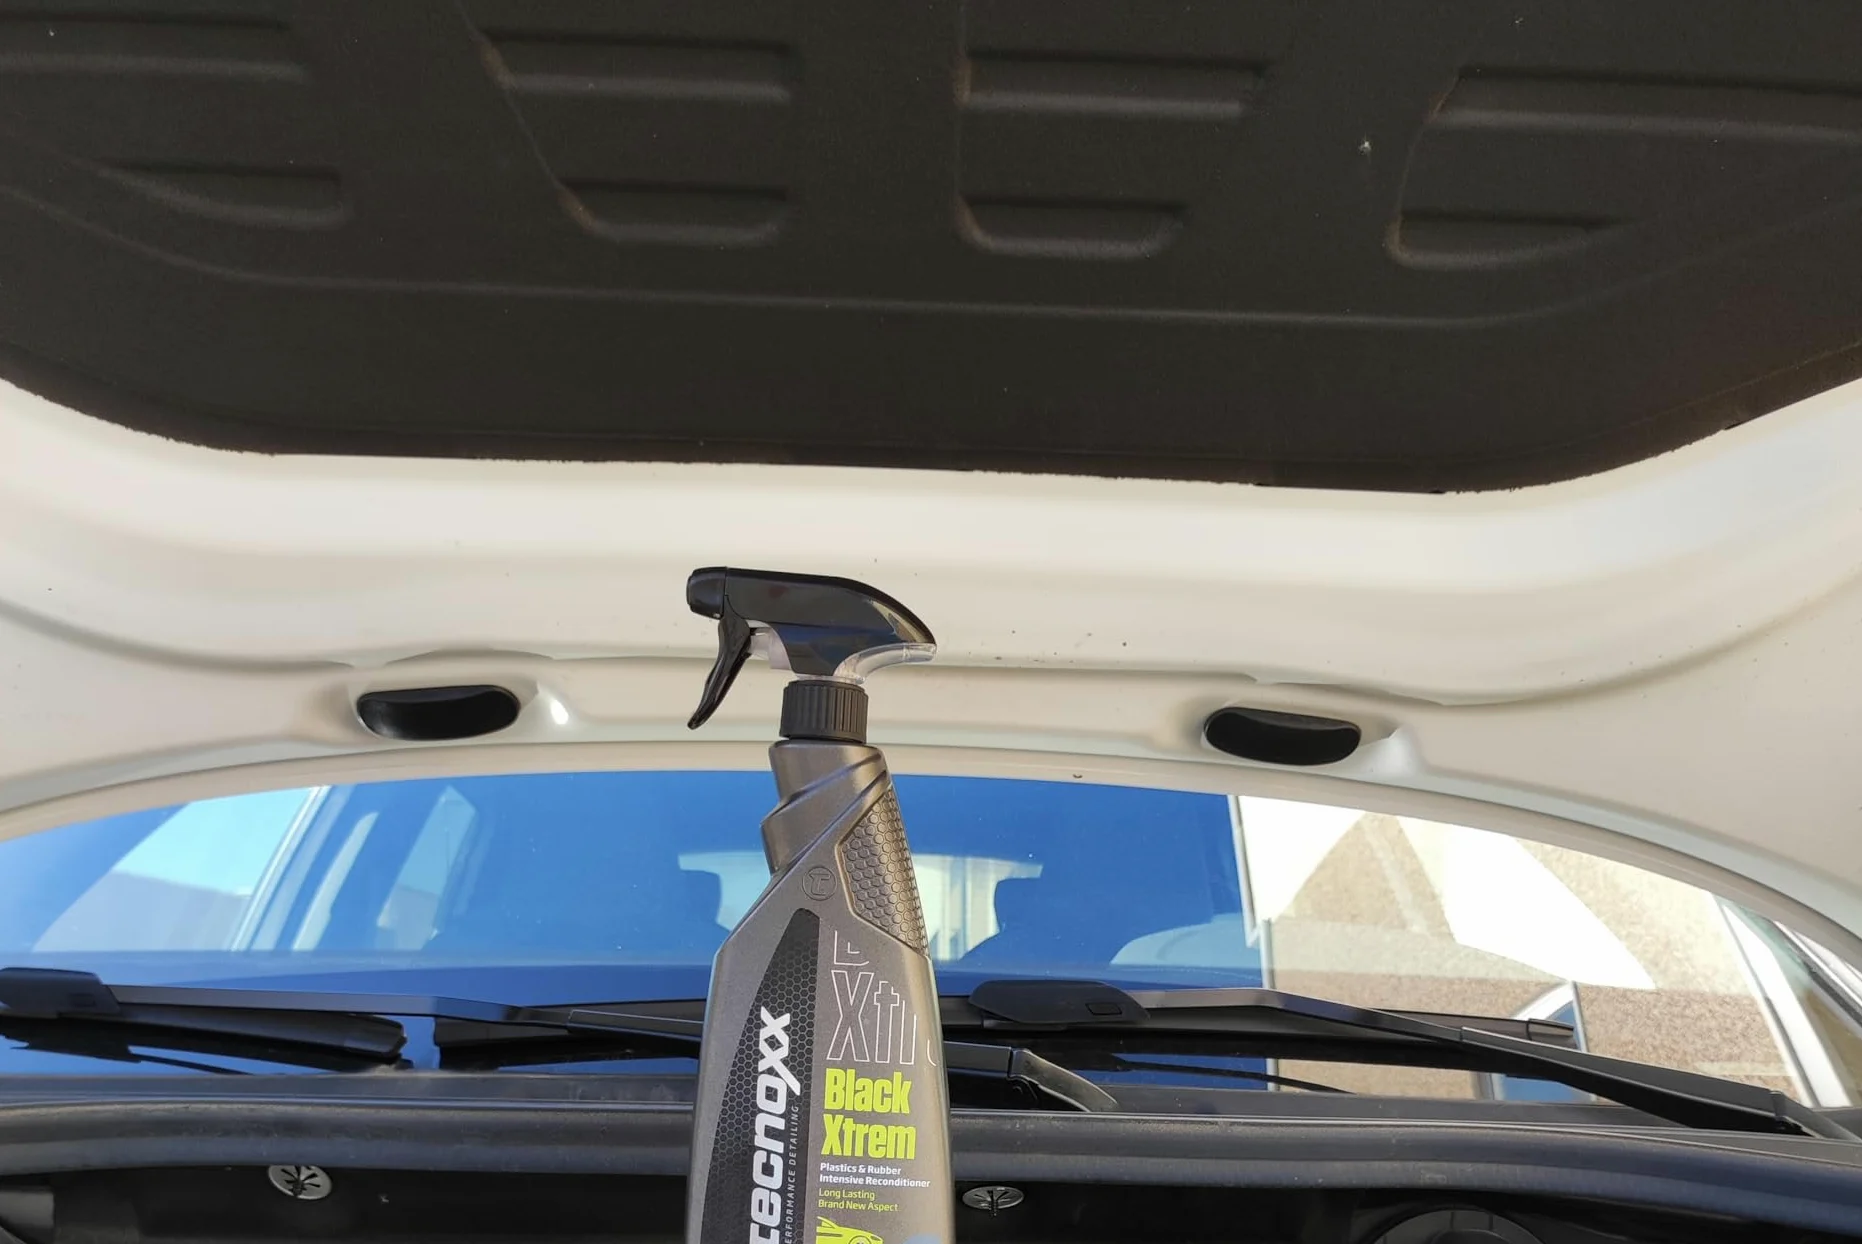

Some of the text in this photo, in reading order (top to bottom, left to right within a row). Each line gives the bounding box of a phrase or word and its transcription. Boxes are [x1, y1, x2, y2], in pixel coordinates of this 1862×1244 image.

[824, 1067, 912, 1114] Black
[789, 1105, 799, 1166] DETAILING
[820, 1113, 917, 1160] Xtrem
[820, 1162, 902, 1175] Plastics & Rubber
[819, 1174, 931, 1188] Intensive Reconditioner
[818, 1188, 876, 1201] Long Lasting
[818, 1199, 898, 1212] Brand New Aspect
